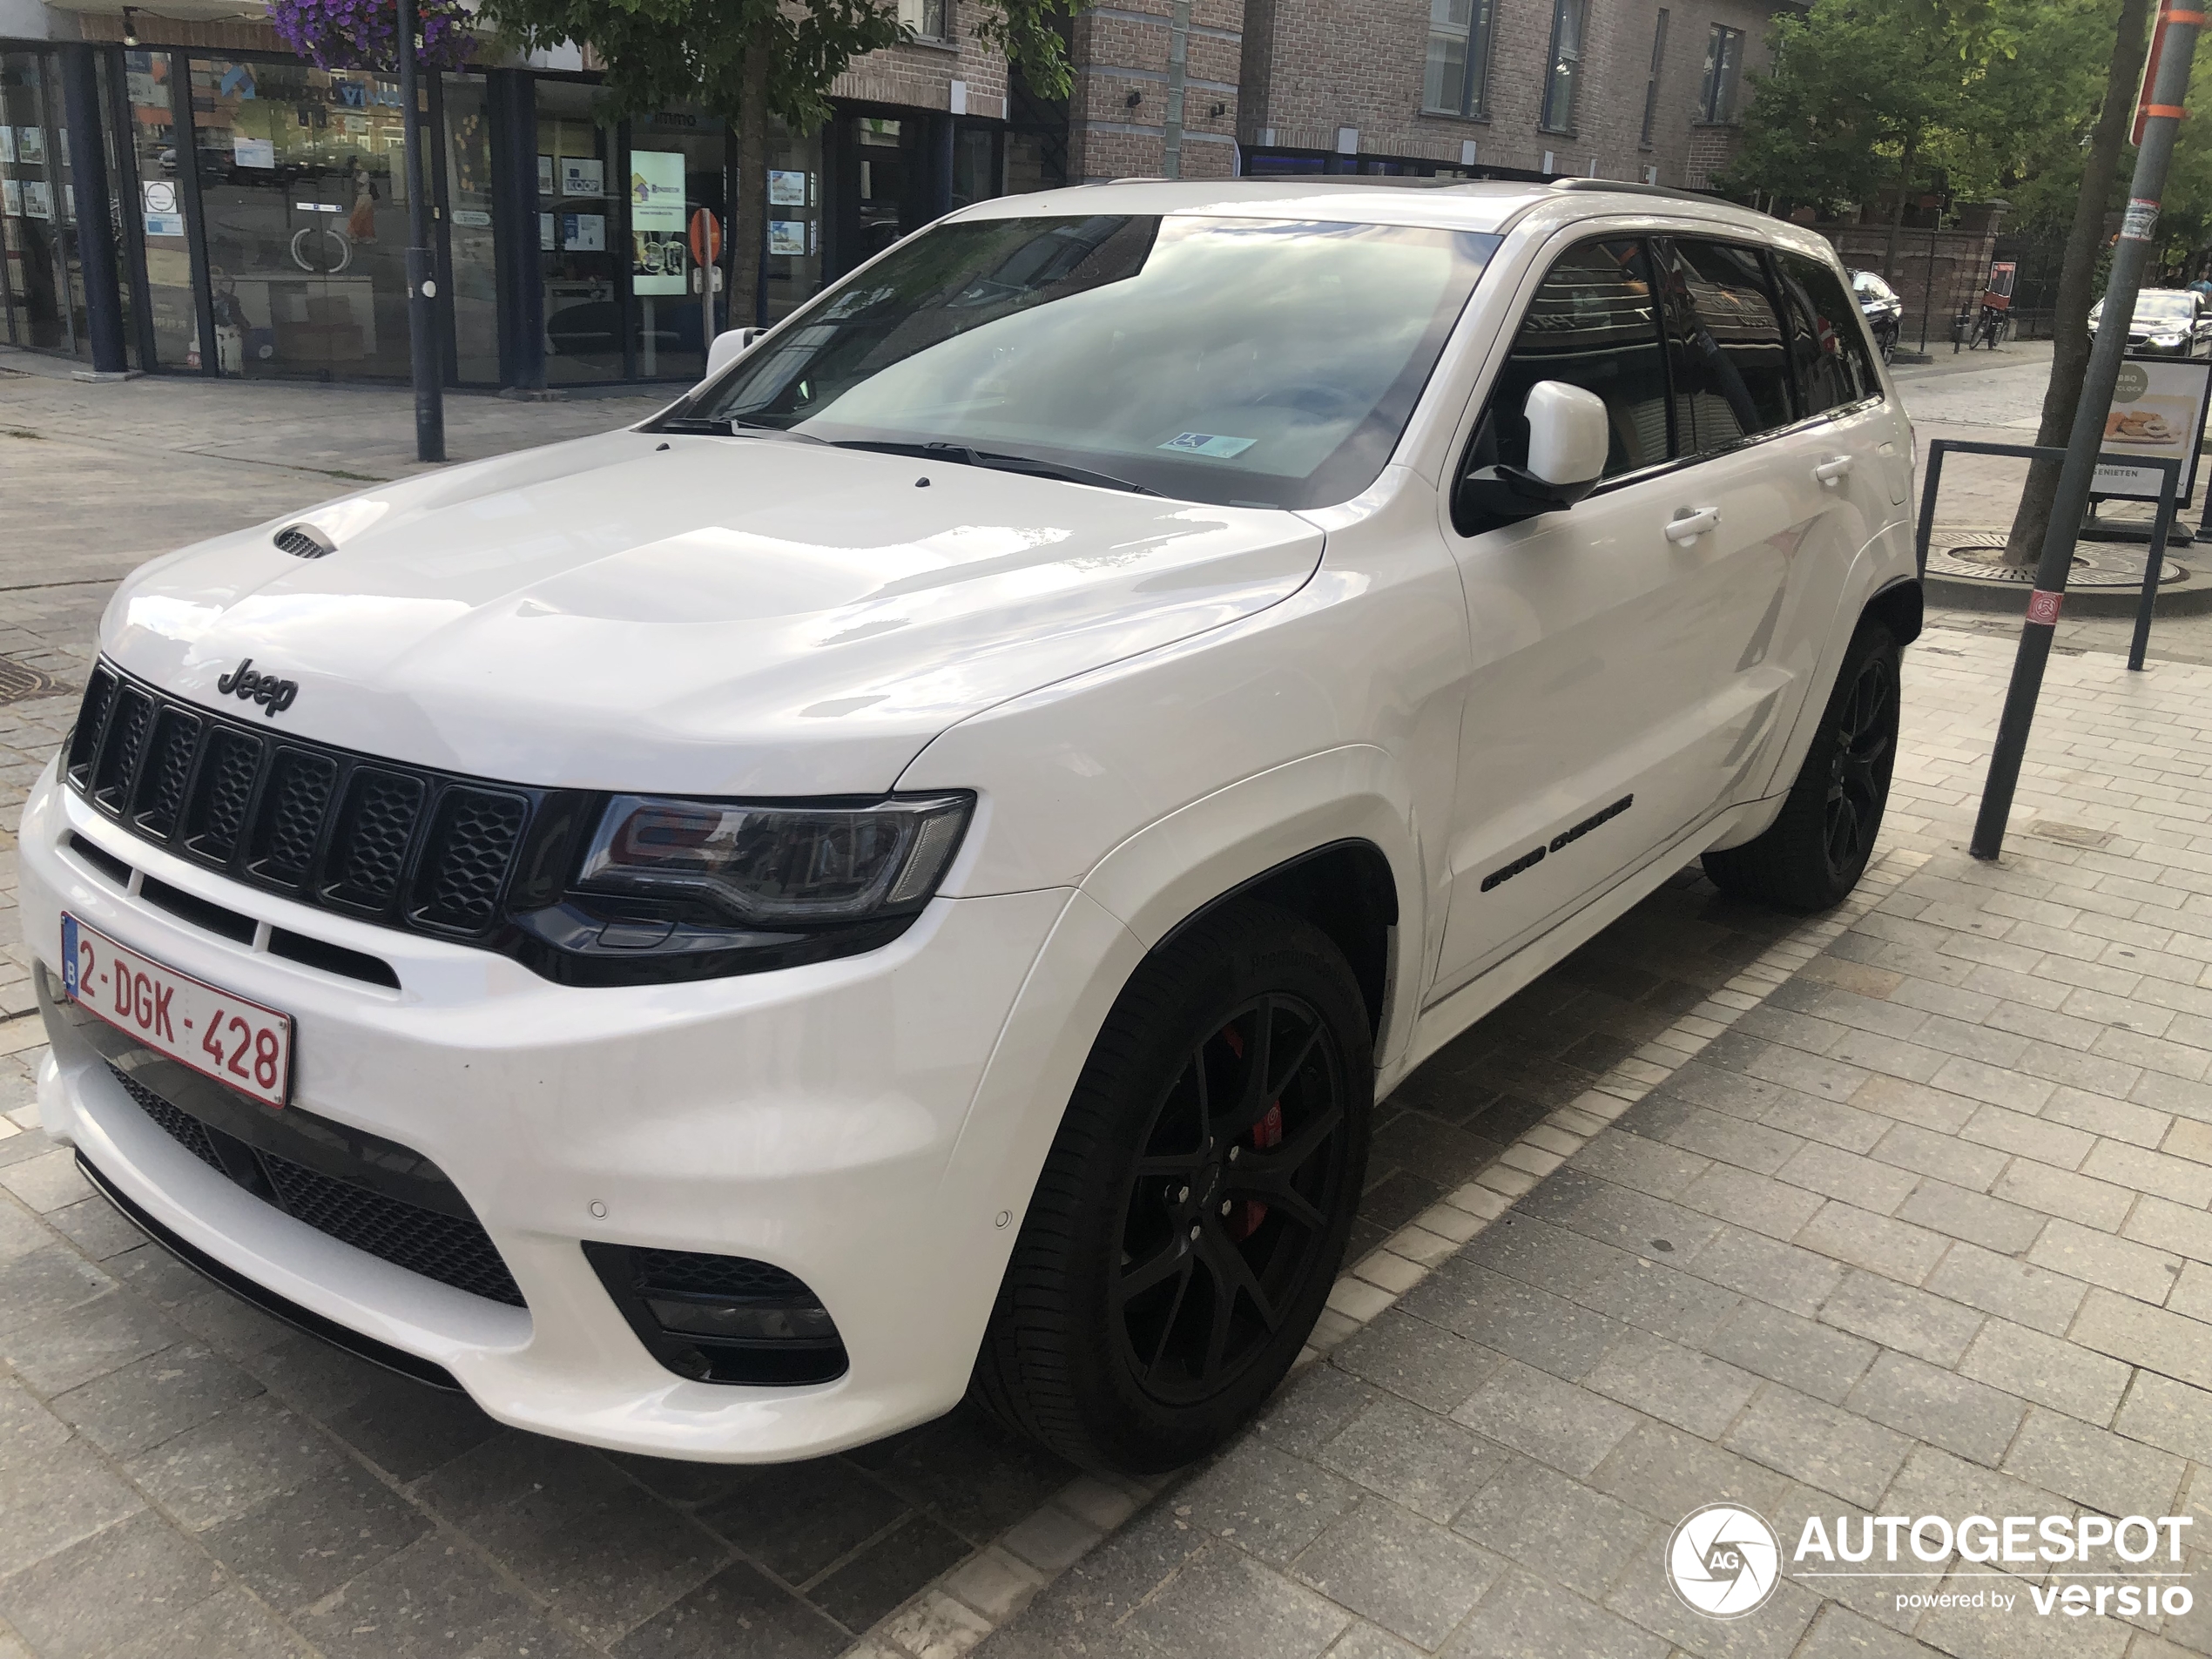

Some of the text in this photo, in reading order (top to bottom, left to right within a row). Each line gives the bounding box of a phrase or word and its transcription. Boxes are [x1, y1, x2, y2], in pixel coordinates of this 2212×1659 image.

[2118, 374, 2137, 383] BBQ
[218, 658, 299, 718] Jeep
[66, 961, 76, 986] B
